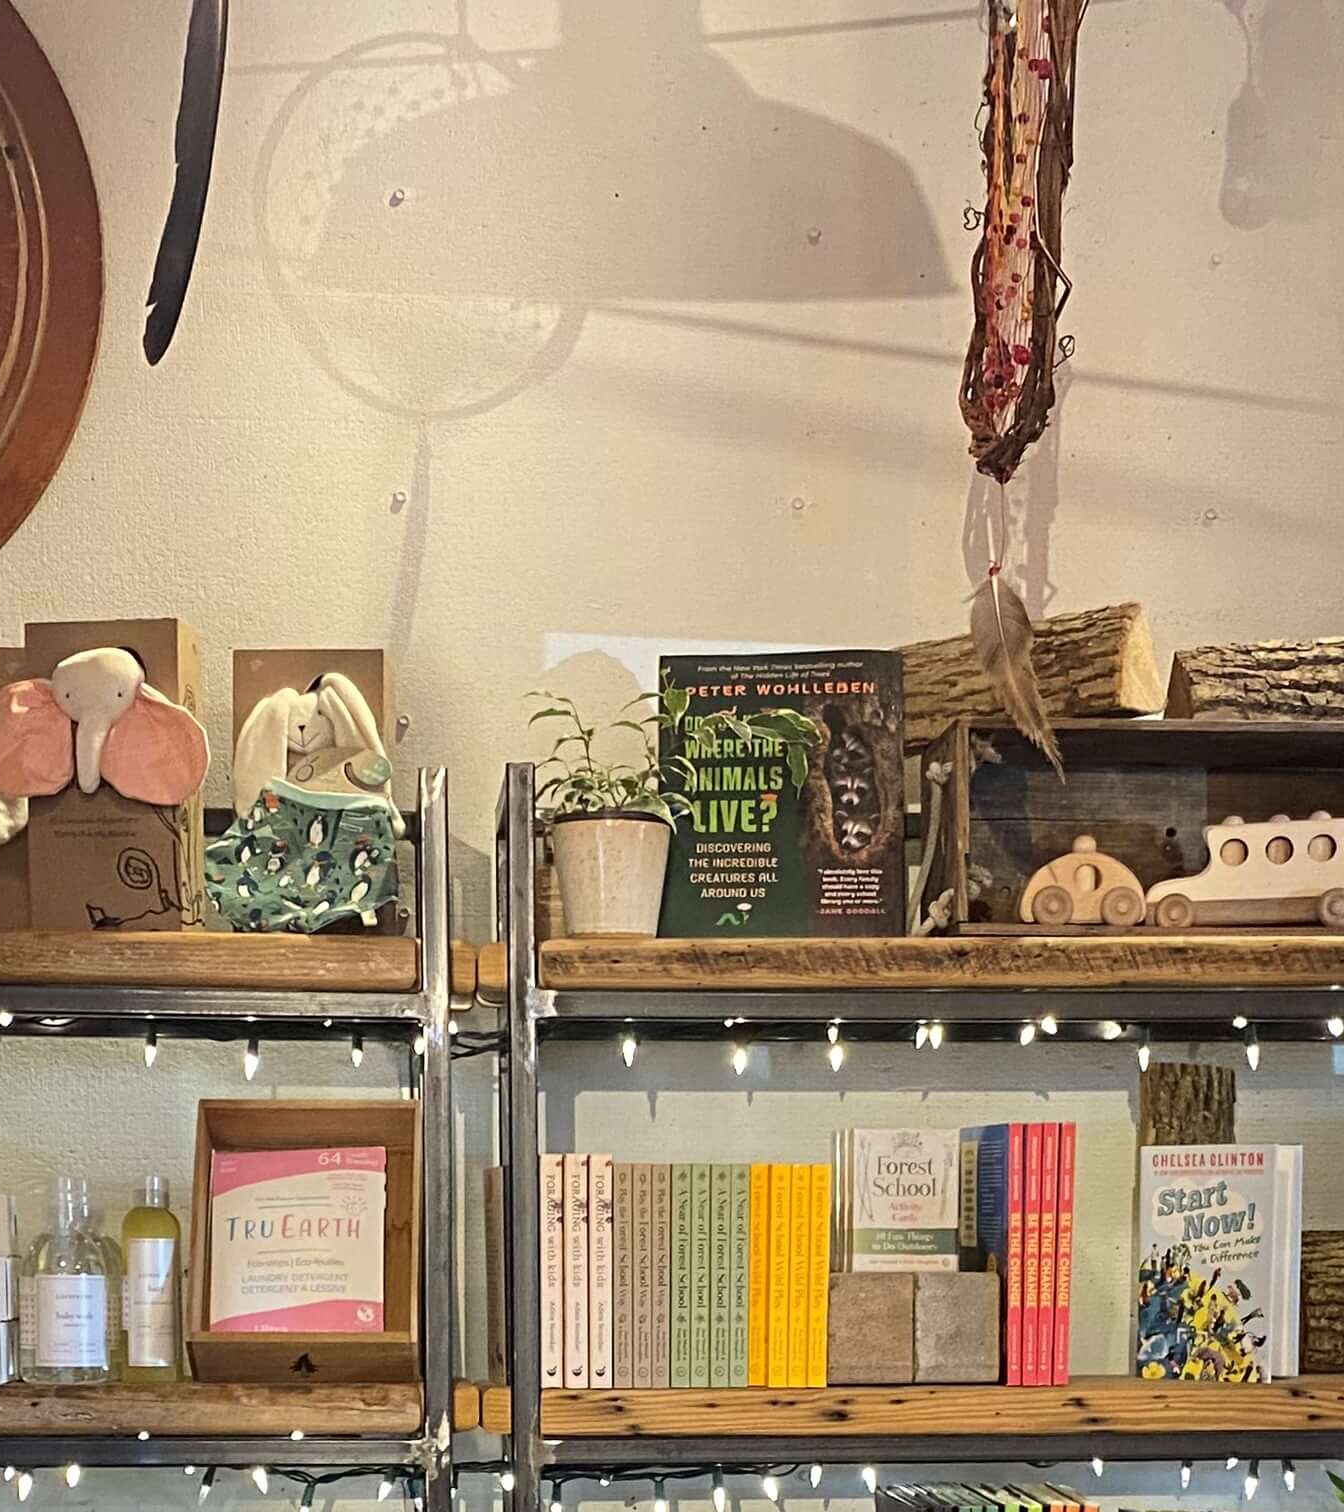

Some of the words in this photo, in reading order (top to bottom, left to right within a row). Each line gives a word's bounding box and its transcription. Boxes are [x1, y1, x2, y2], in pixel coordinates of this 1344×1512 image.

[686, 685, 747, 697] PETER
[751, 739, 784, 758] THE
[684, 767, 784, 792] ANIMALS
[692, 795, 778, 833] LIVE?
[696, 843, 771, 853] DISCOVERING
[688, 858, 709, 868] THE
[712, 857, 778, 868] INCREDIBLE
[690, 873, 755, 883] CREATURES
[758, 873, 779, 882] ALL
[700, 888, 747, 898] AROUND
[750, 888, 766, 898] US
[318, 1152, 342, 1166] 64
[877, 1155, 932, 1176] Forest
[1152, 1153, 1206, 1168] CHELSEA
[1210, 1152, 1264, 1167] CLINTON
[872, 1178, 936, 1198] School
[1157, 1181, 1228, 1217] Start
[226, 1217, 274, 1241] TRU
[281, 1214, 361, 1239] EARTH
[1182, 1203, 1256, 1241] Now!
[596, 1236, 606, 1260] with
[1059, 1231, 1070, 1255] THE
[1192, 1244, 1210, 1253] You
[1212, 1240, 1232, 1249] Can
[1234, 1237, 1261, 1247] Make
[1209, 1251, 1259, 1264] Difference
[596, 1263, 607, 1288] kids
[1058, 1258, 1069, 1308] CHANGE
